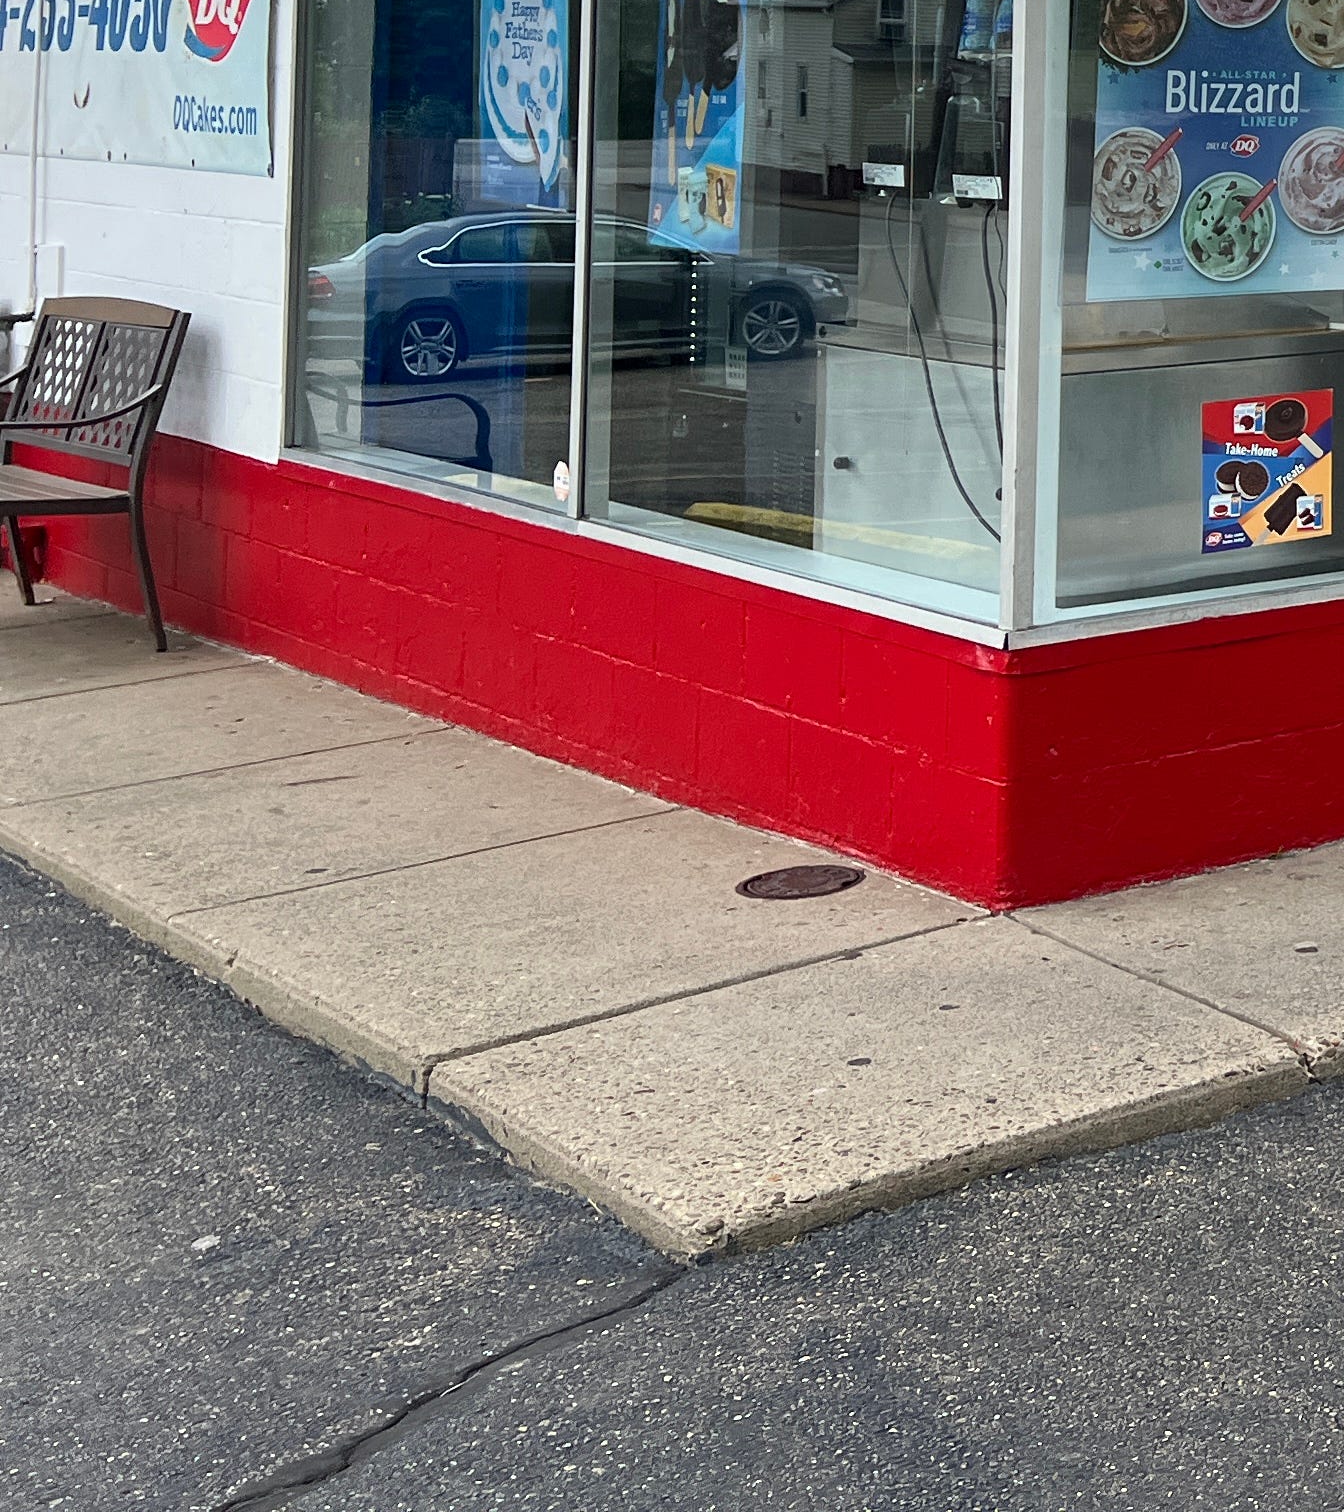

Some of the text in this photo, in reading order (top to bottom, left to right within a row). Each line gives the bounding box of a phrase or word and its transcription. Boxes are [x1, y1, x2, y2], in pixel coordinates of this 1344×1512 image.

[511, 1, 541, 28] Happy
[511, 41, 535, 66] Day
[1219, 69, 1276, 80] ALL-STAR
[1165, 69, 1301, 114] Blizzard
[173, 94, 258, 136] DQCakes.com
[1240, 116, 1300, 128] LINEUP
[1234, 139, 1256, 153] DQ
[1224, 441, 1279, 458] Take-Home
[1275, 462, 1307, 488] Treats
